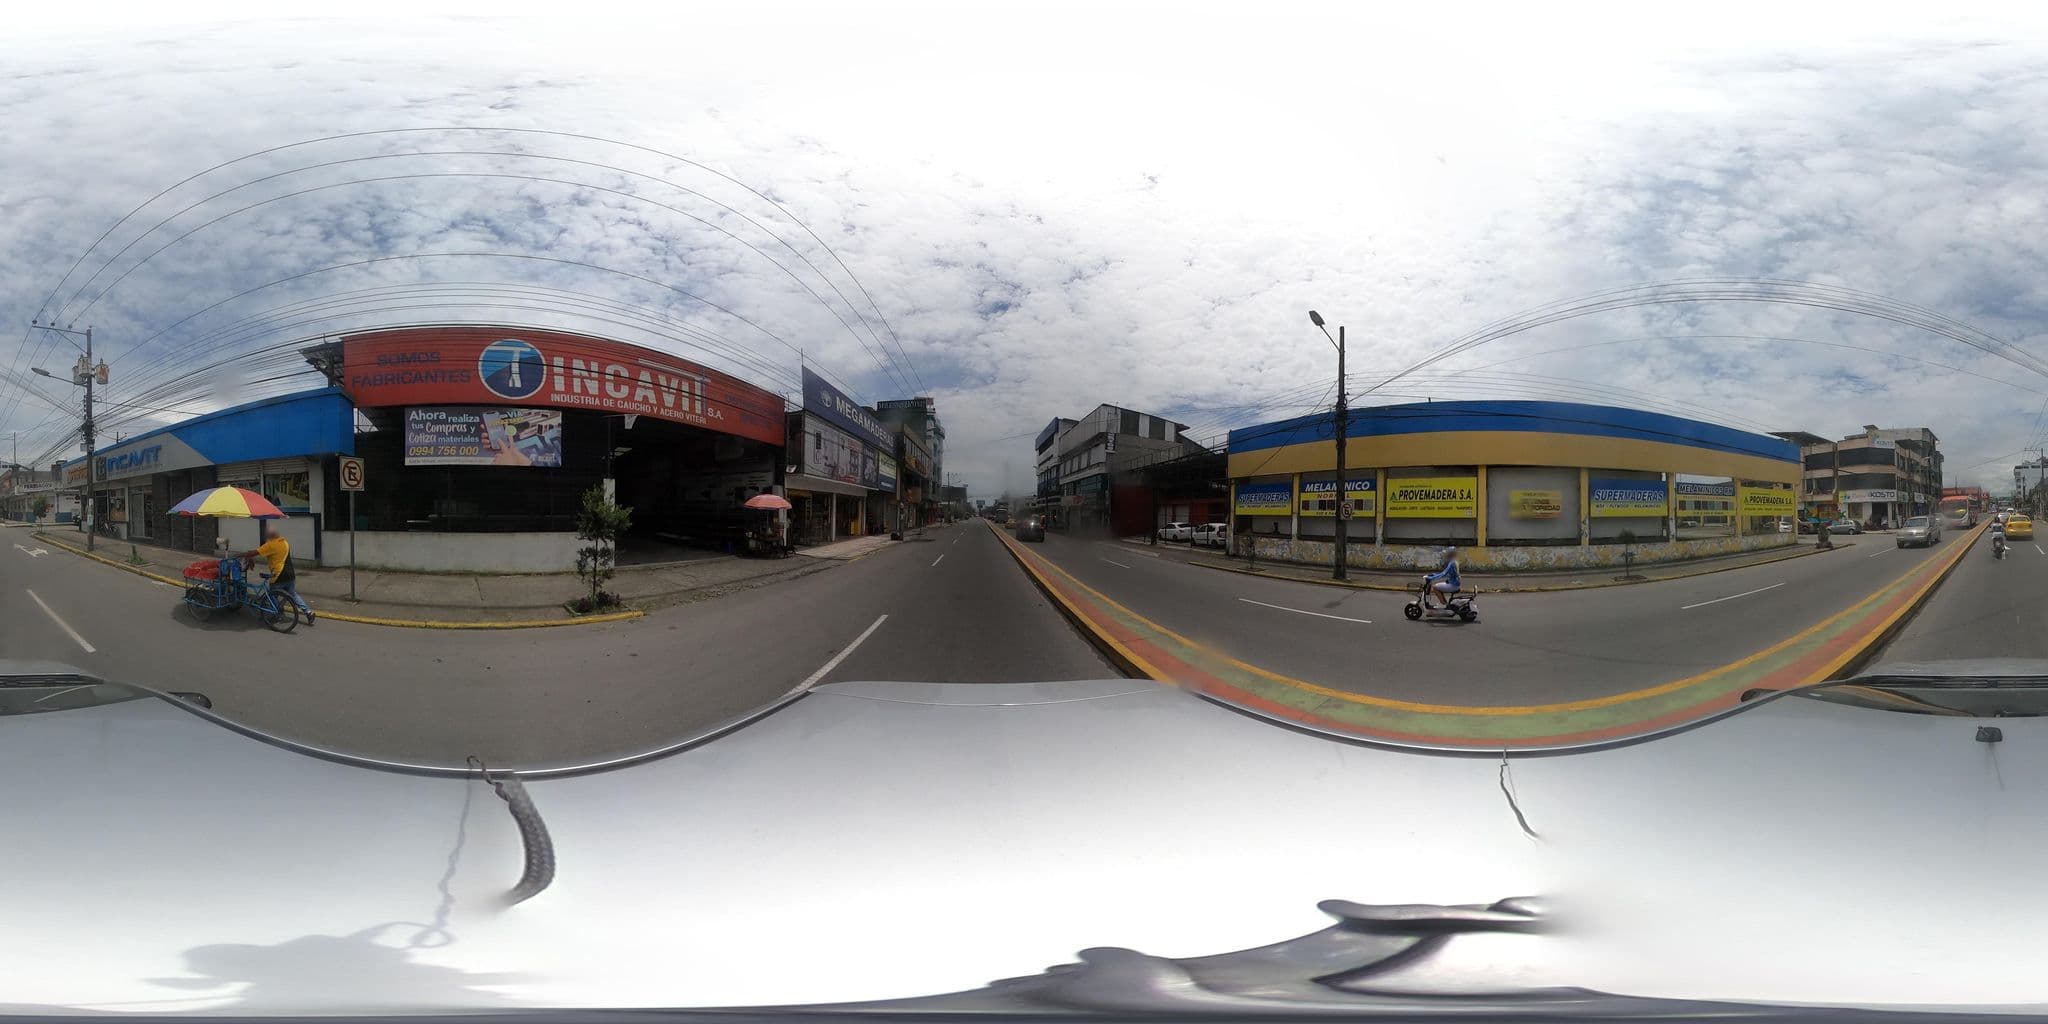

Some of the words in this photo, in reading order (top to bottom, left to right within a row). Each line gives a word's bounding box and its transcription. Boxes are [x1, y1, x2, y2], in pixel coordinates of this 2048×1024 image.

[377, 351, 440, 366] SOMOS
[352, 370, 471, 388] FABRICANTES
[552, 356, 711, 415] INCAVIT
[551, 393, 601, 407] INDUSTRIA
[603, 398, 616, 409] DE
[617, 399, 651, 413] CAUCHO
[653, 406, 658, 415] Y
[659, 408, 684, 420] ACERO
[409, 410, 447, 421] Ahora
[448, 414, 480, 423] realiza
[707, 407, 725, 421] S.A.
[836, 396, 895, 447] MEGAMADERAS
[411, 422, 424, 430] tus
[426, 422, 468, 436] Compras
[470, 426, 476, 434] y
[408, 432, 437, 444] Cotiza
[438, 434, 480, 443] materiales
[409, 446, 434, 456] 0994
[437, 446, 457, 456] 756
[460, 446, 479, 456] 000
[1304, 481, 1370, 493] MELAMNICO
[1398, 488, 1457, 501] PROVEMADERA
[1459, 488, 1474, 500] S.A.
[1594, 489, 1665, 502] SUPERMADERAS
